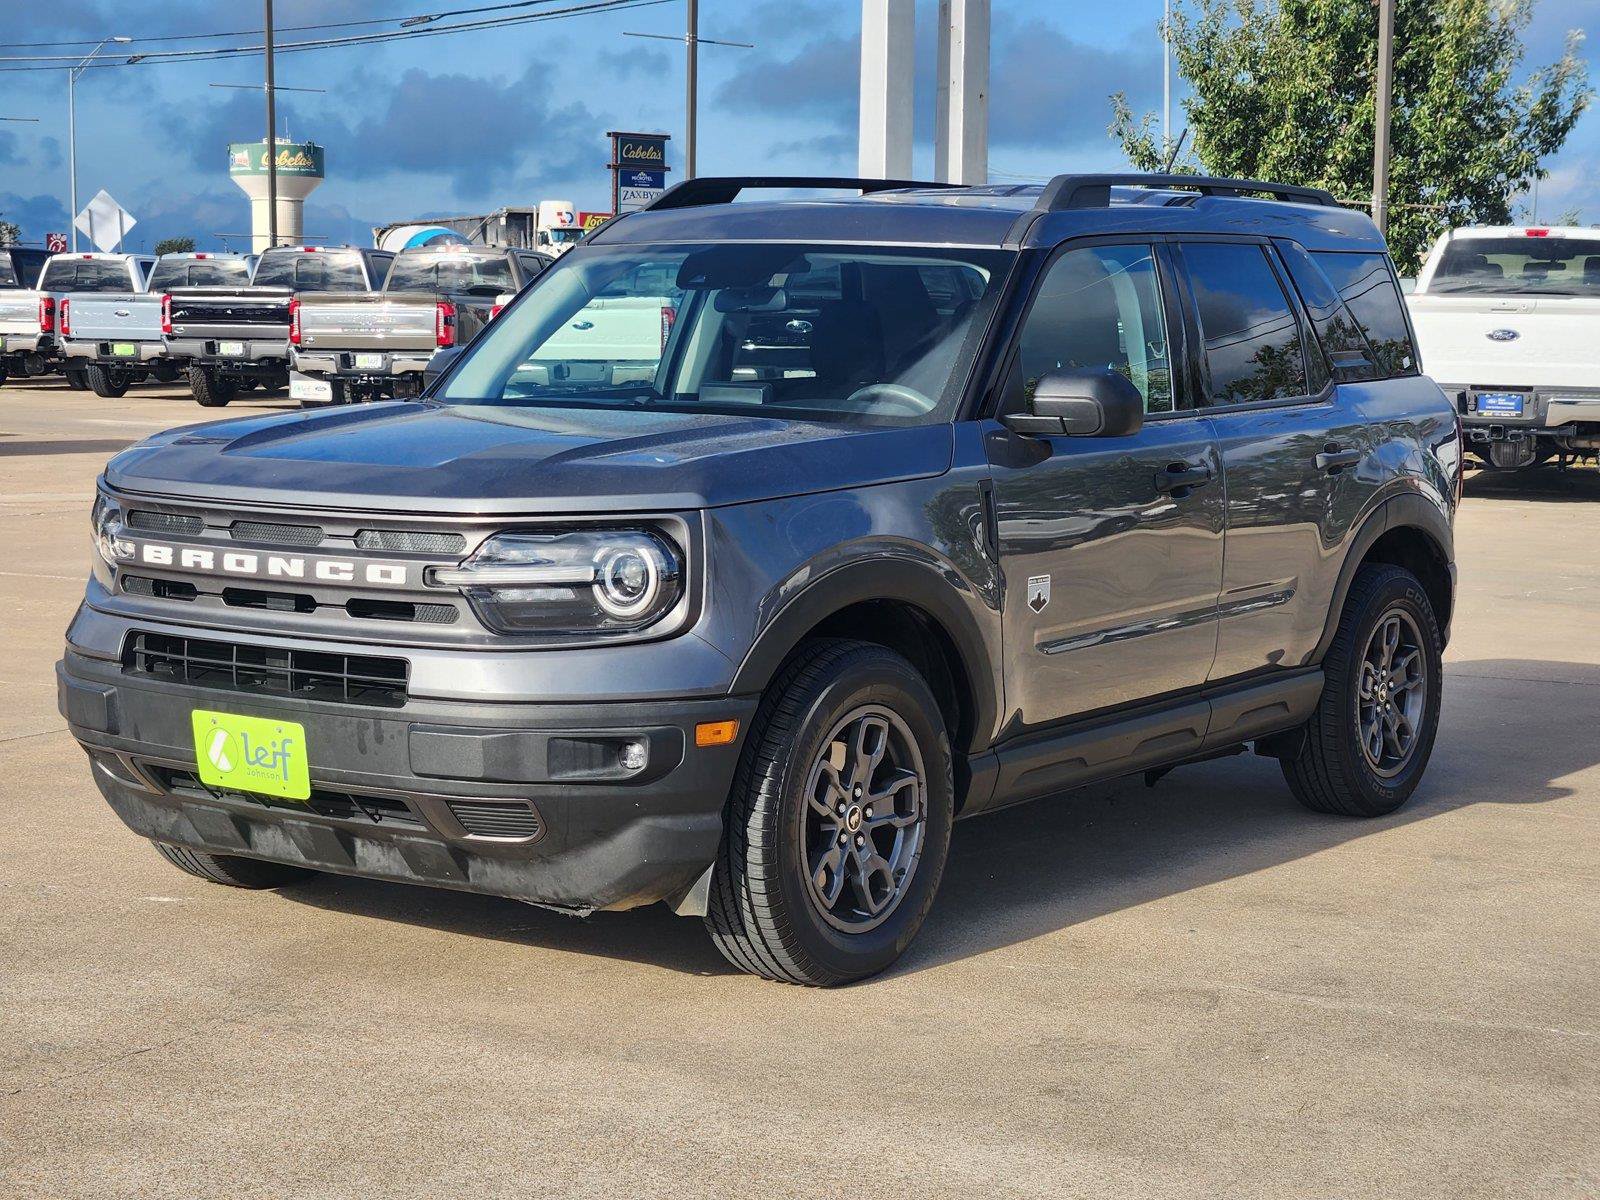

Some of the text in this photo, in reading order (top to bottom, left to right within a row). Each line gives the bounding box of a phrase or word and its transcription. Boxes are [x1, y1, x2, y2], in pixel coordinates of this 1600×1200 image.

[622, 143, 662, 160] Cabela's
[143, 544, 407, 585] BRONCO
[240, 732, 293, 782] leif
[246, 767, 281, 781] Johnson
